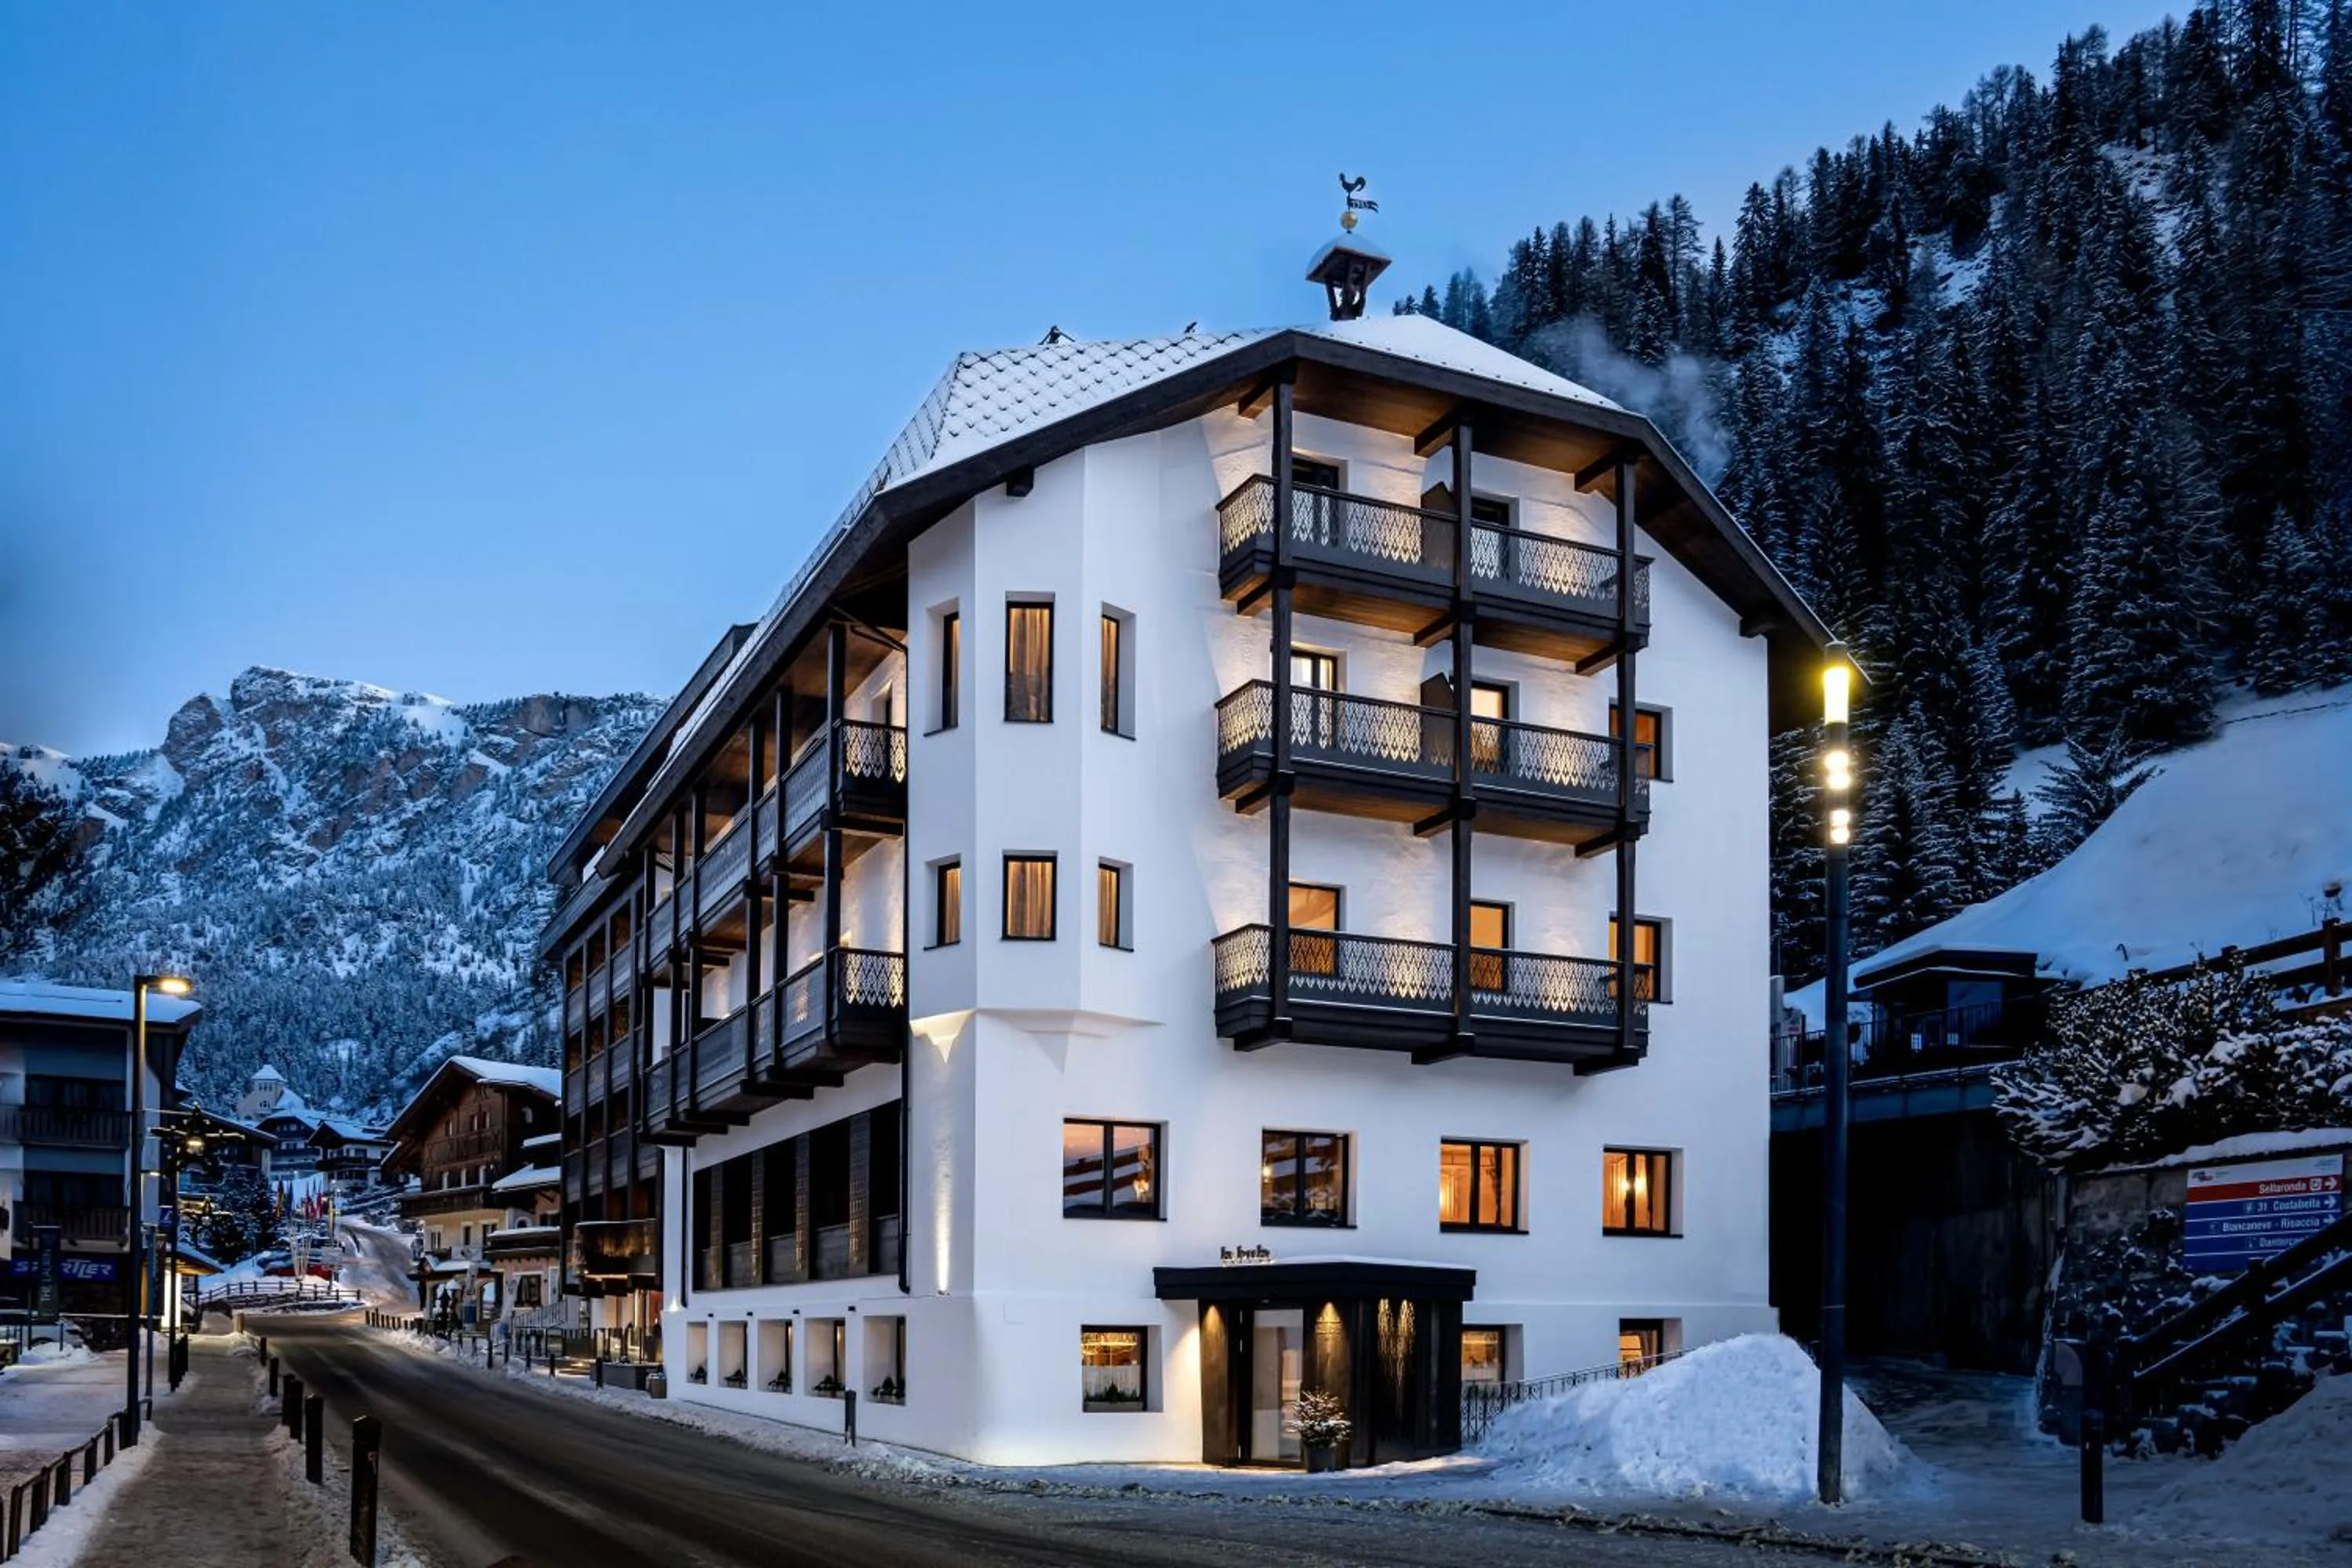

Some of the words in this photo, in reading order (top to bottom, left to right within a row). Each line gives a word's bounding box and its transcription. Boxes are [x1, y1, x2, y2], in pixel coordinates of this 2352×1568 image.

[2259, 1178, 2307, 1194] Sellaronda
[2273, 1197, 2321, 1210] Costabella
[2223, 1219, 2272, 1232] Biancaneve
